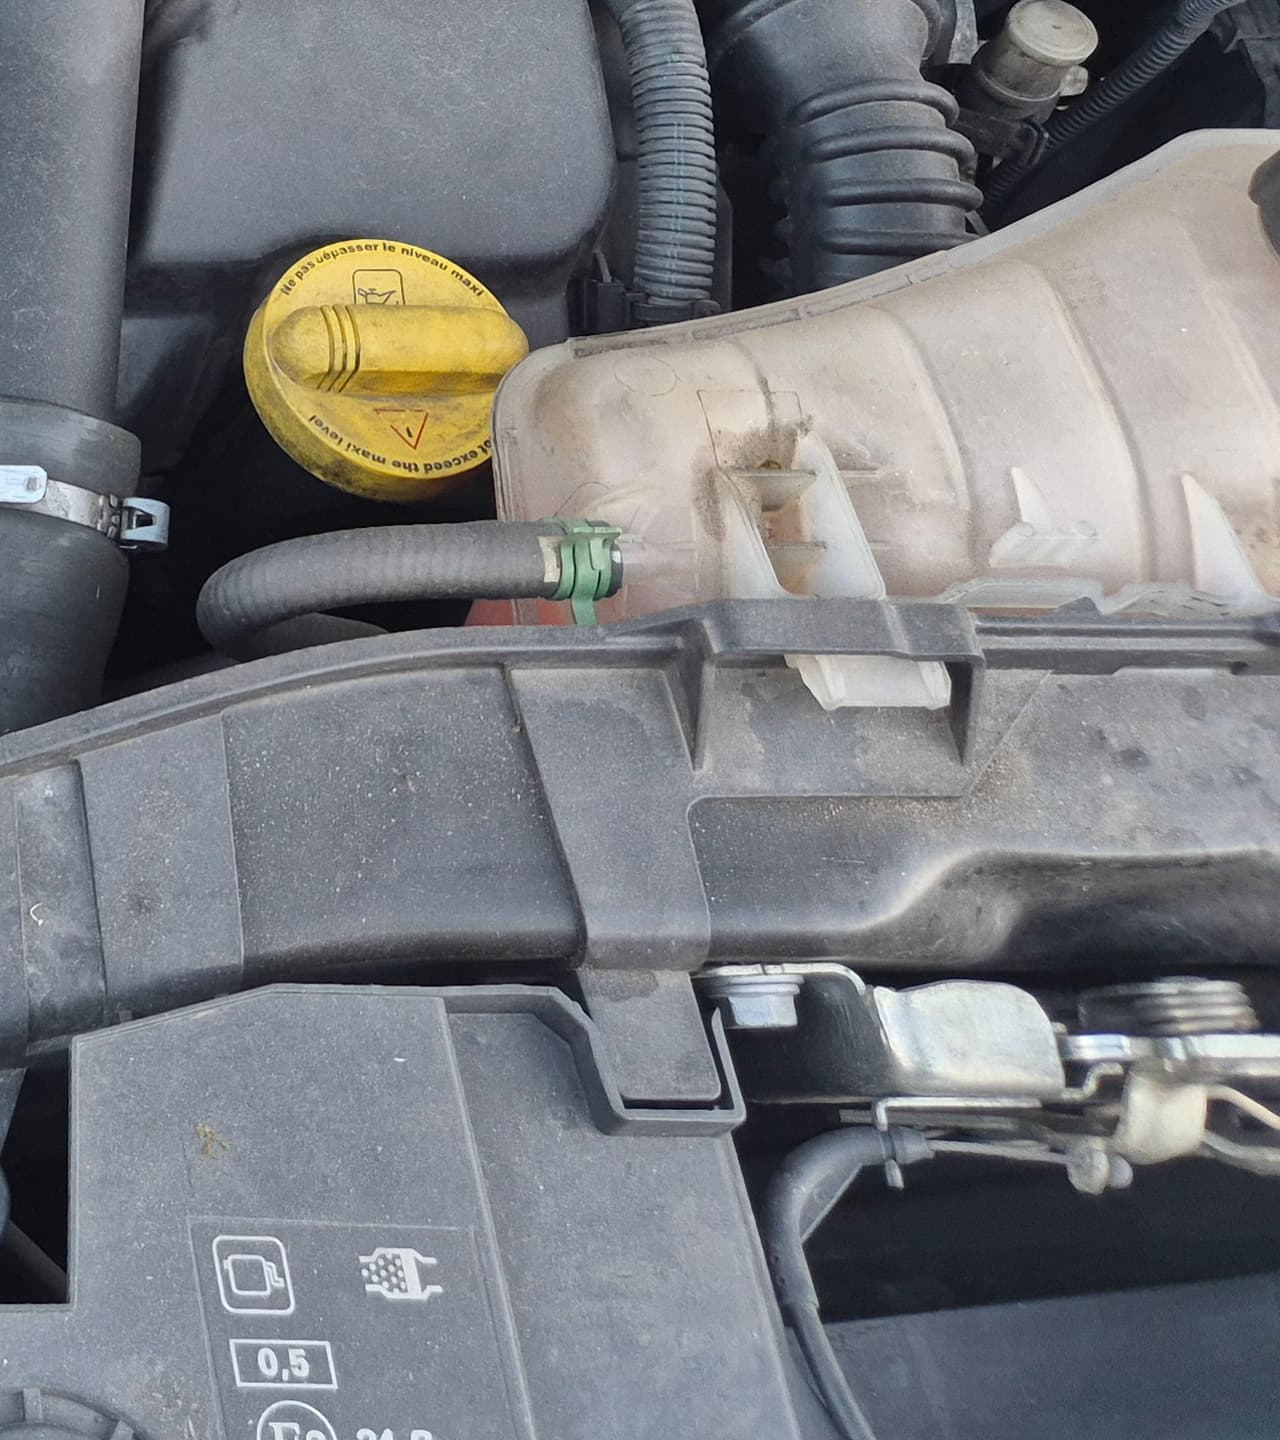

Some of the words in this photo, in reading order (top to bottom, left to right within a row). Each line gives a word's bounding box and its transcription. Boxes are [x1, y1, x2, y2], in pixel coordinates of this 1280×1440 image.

[295, 260, 316, 281] pas
[382, 242, 396, 254] le
[401, 247, 449, 272] niveau
[450, 269, 484, 297] maxi
[307, 414, 345, 445] level
[344, 442, 386, 466] maxi
[392, 460, 420, 473] the
[423, 448, 479, 474] exceed
[257, 1347, 310, 1382] 0,5
